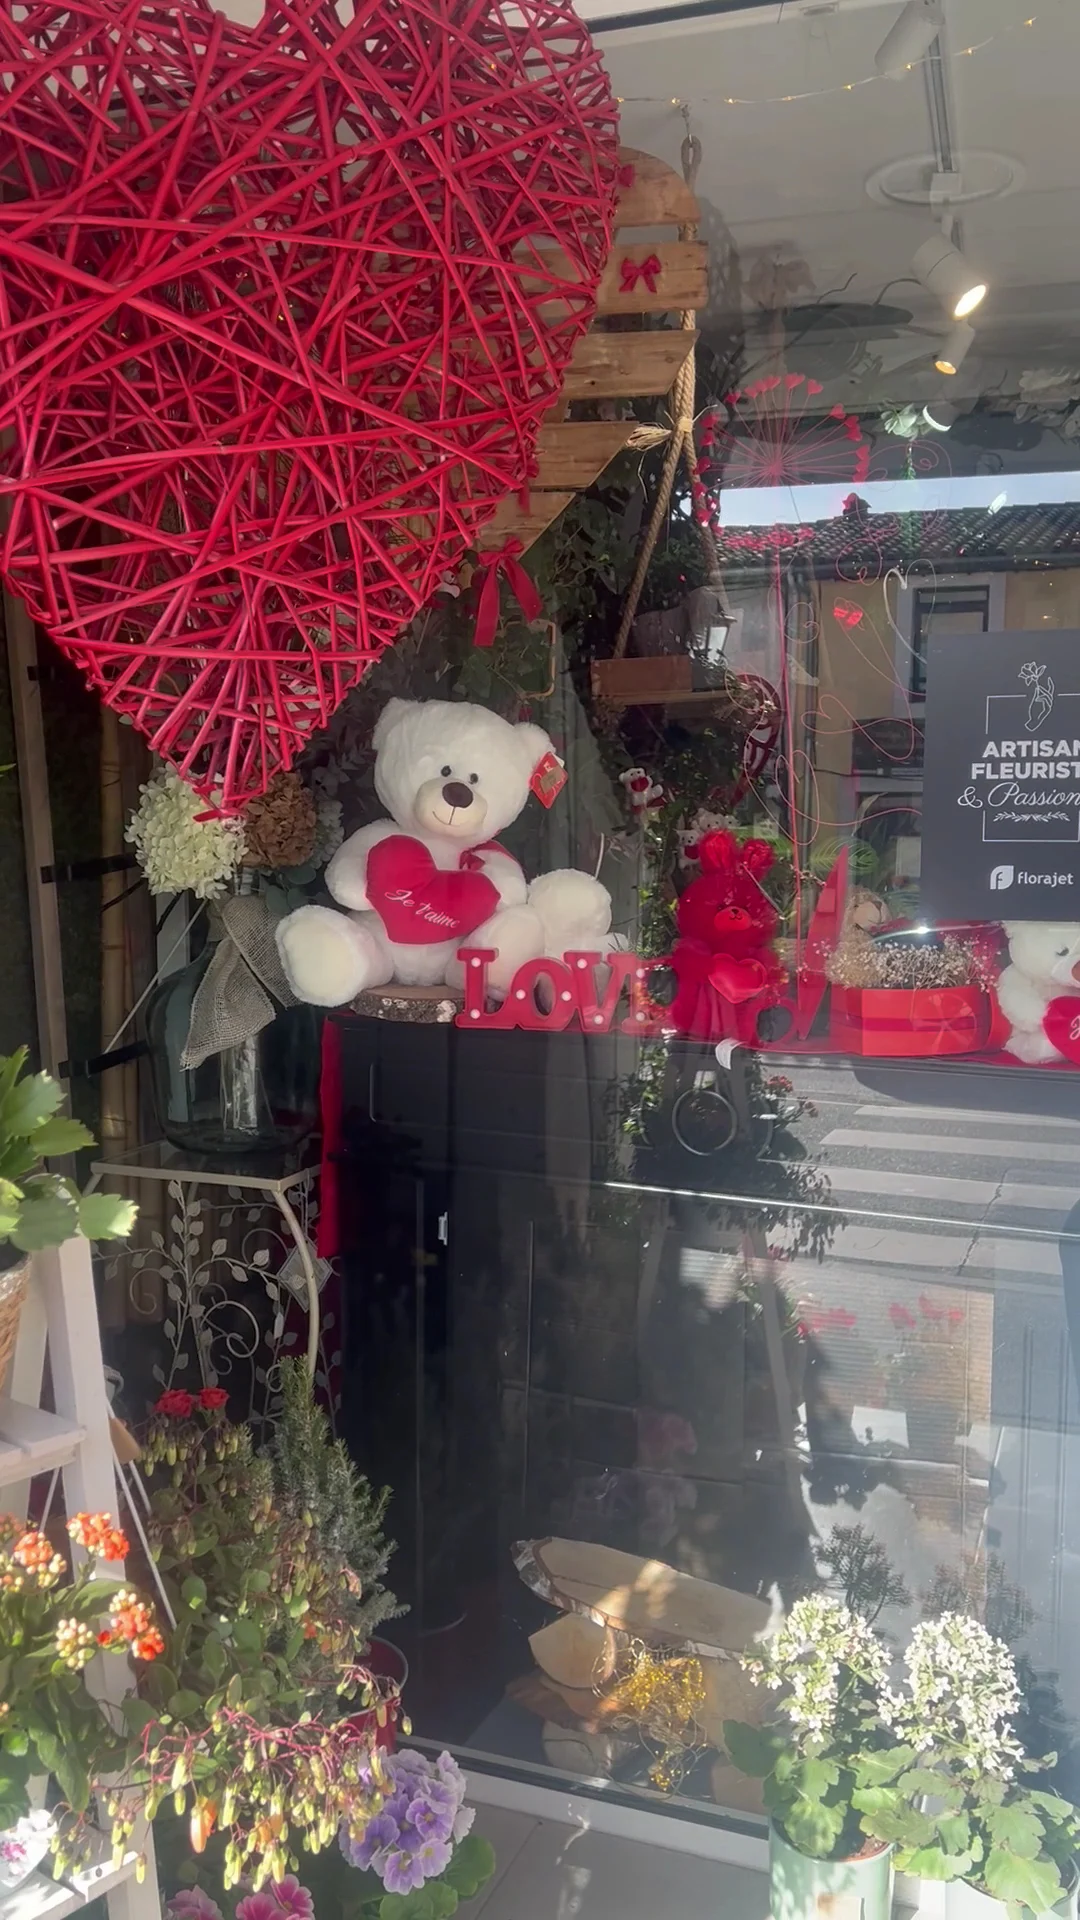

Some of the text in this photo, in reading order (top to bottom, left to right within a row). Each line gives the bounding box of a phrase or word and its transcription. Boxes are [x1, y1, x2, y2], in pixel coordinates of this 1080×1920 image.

[957, 781, 1080, 809] & Passion
[1017, 871, 1074, 888] florajet
[384, 889, 460, 929] Je t'aime
